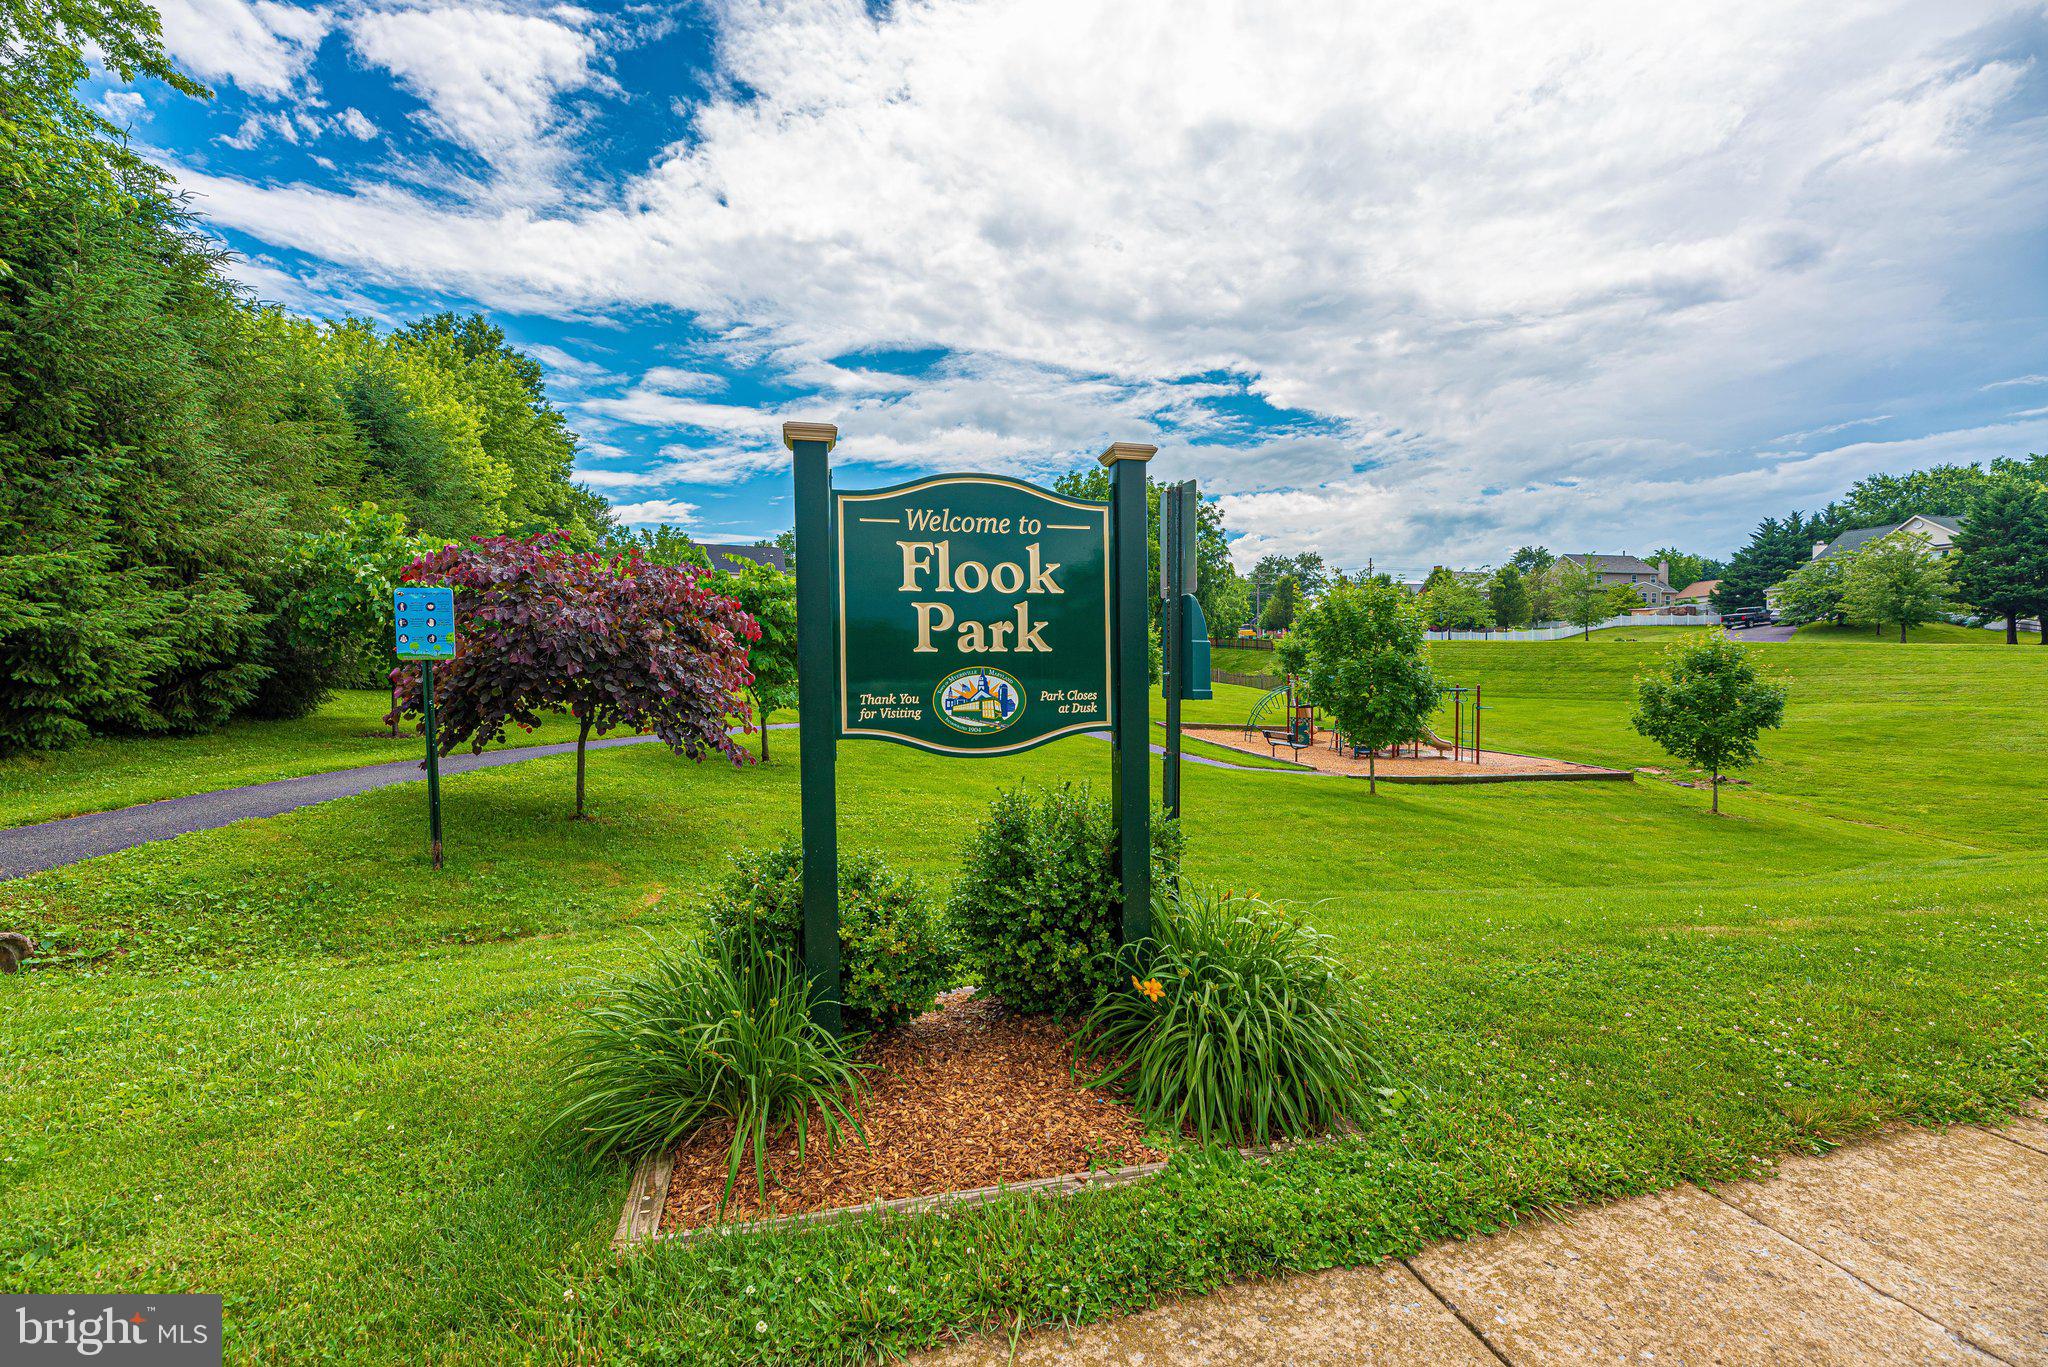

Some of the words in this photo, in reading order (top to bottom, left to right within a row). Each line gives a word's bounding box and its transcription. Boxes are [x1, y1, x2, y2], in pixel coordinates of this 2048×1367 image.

[905, 508, 1011, 534] Welcome
[1019, 515, 1042, 535] to
[896, 539, 1065, 594] Flook
[911, 600, 1053, 653] Park
[859, 693, 897, 705] Thank
[900, 693, 920, 705] You
[1040, 690, 1065, 702] Park
[1066, 690, 1098, 701] Closes
[858, 708, 878, 722] for
[880, 707, 922, 721] Visiting
[1059, 704, 1070, 714] at
[1072, 702, 1098, 713] Dusk
